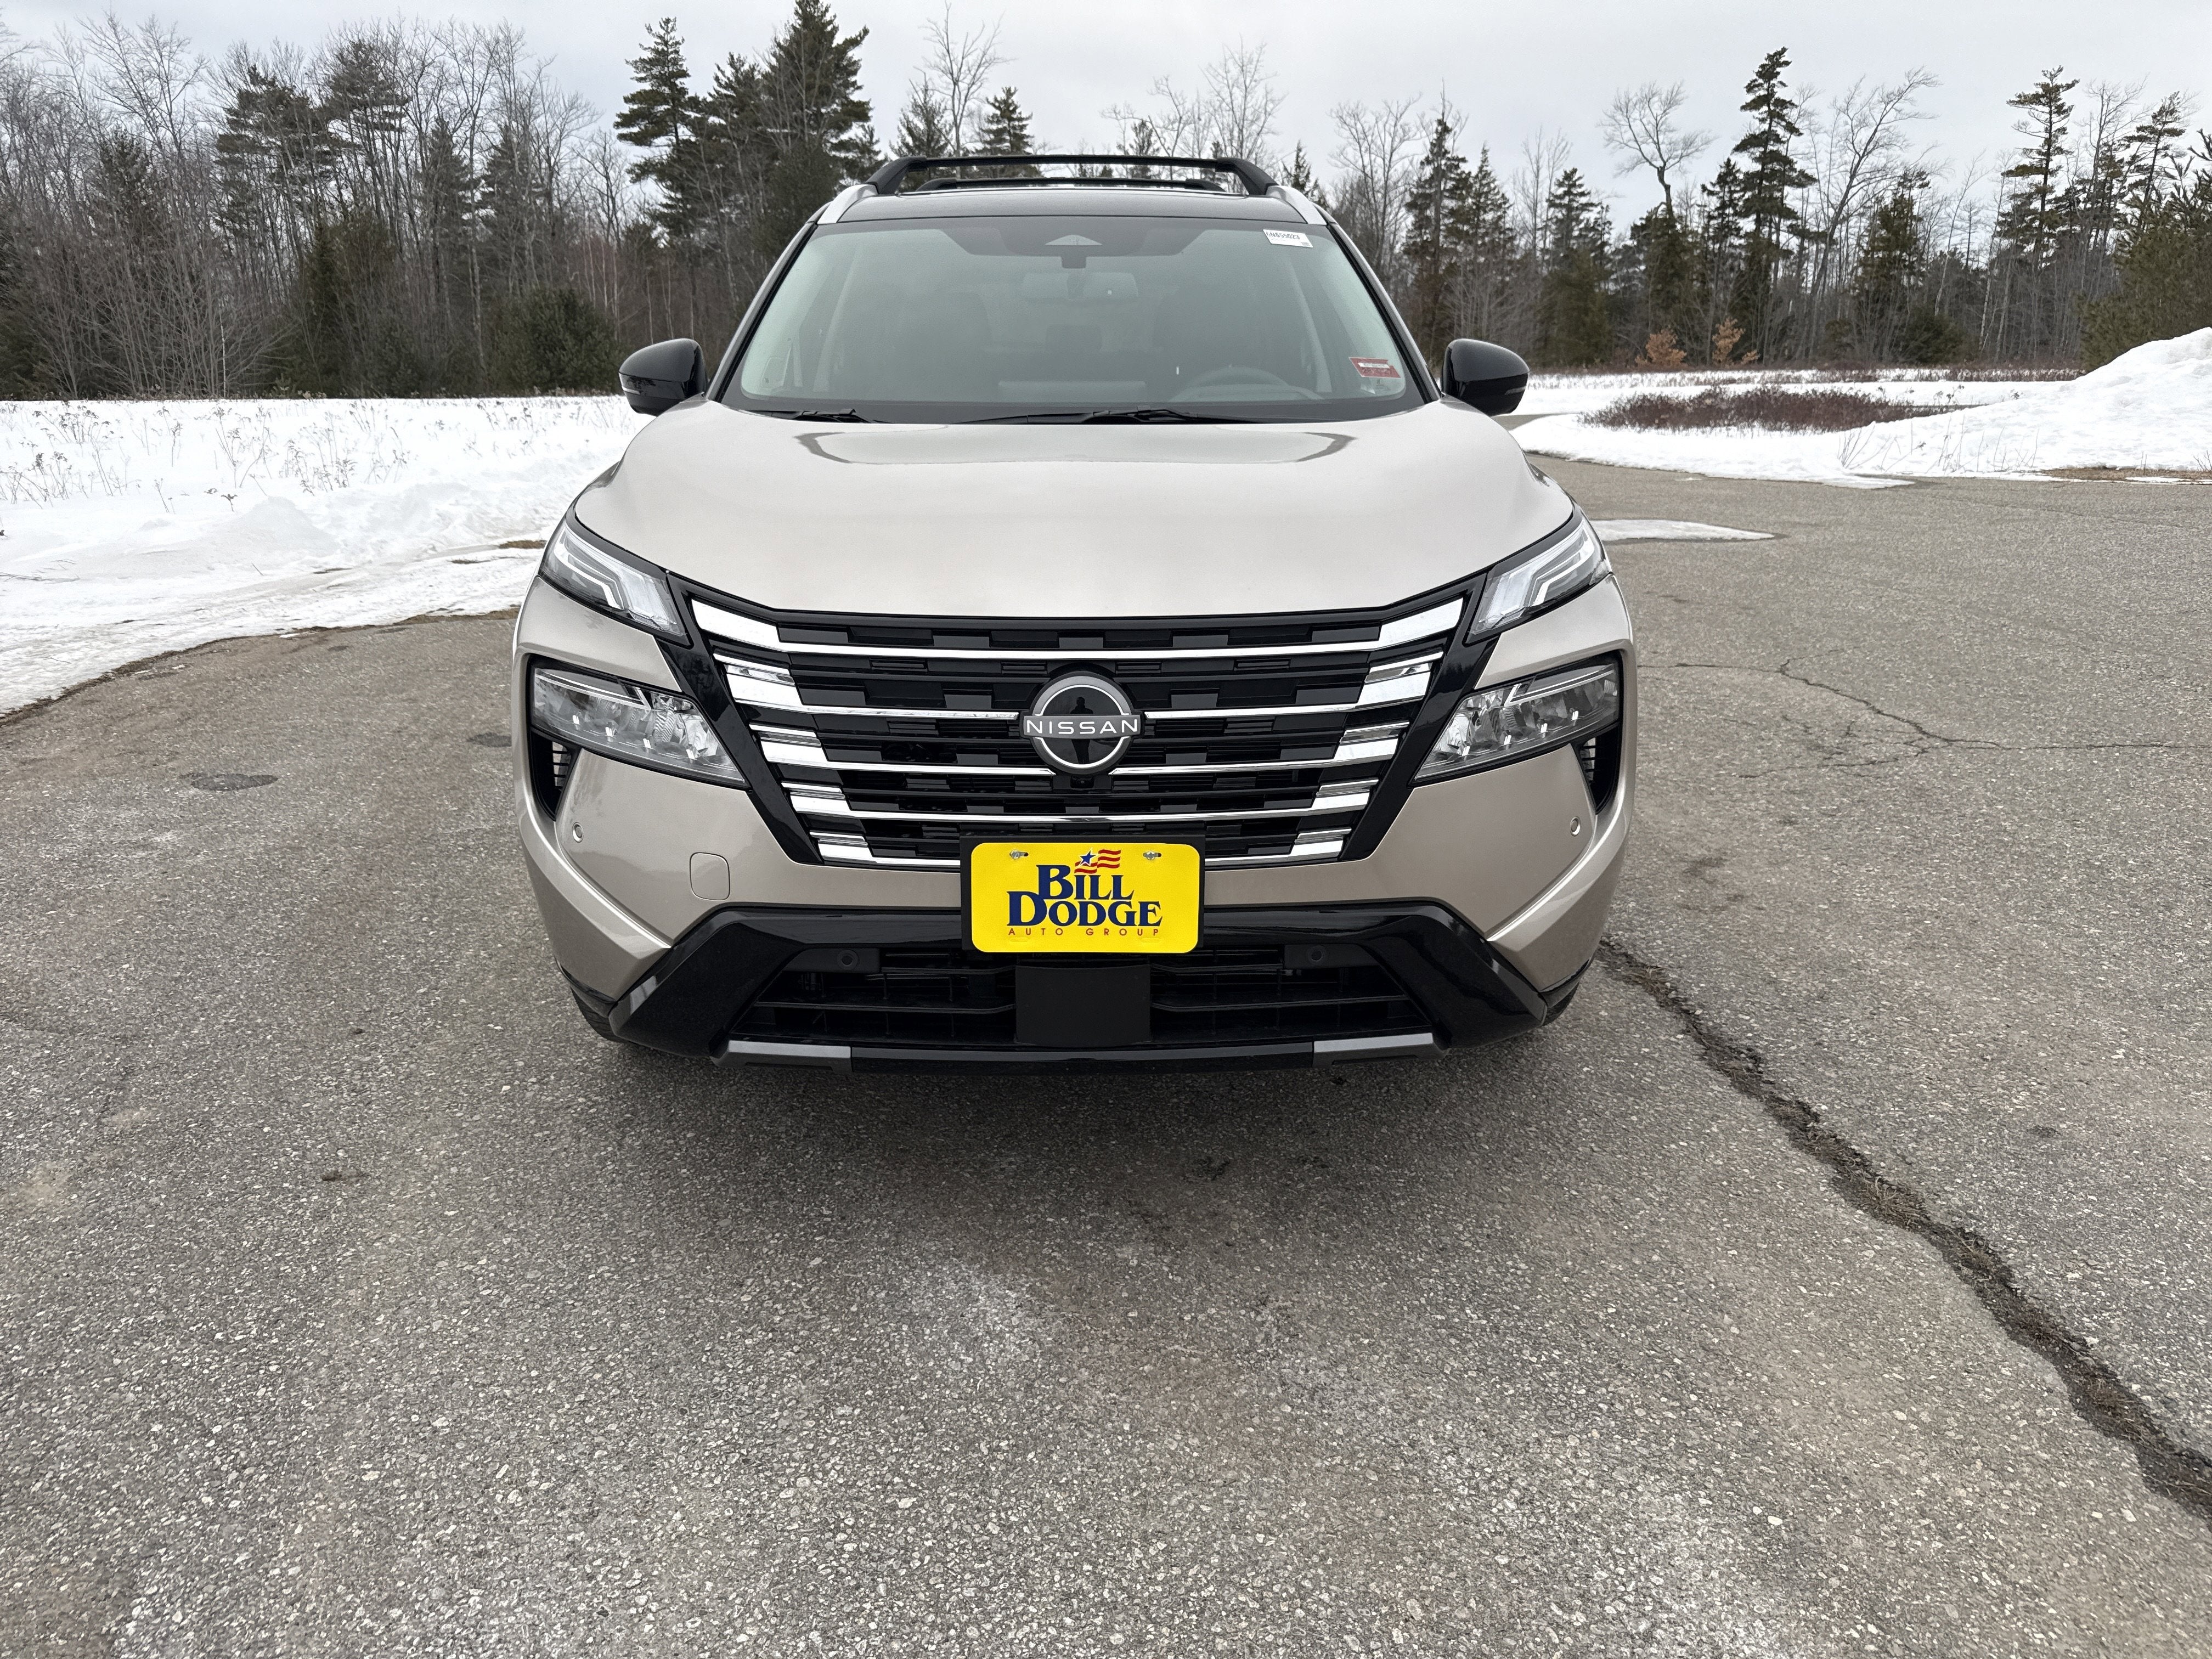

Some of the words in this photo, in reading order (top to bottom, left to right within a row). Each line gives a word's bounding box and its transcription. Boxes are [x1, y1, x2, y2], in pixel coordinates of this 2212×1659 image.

[1026, 719, 1137, 734] NISSAN
[1036, 864, 1135, 900] BILL
[1006, 890, 1164, 927] DODGE
[1008, 927, 1064, 936] AUTO
[1085, 927, 1159, 936] GROUP
